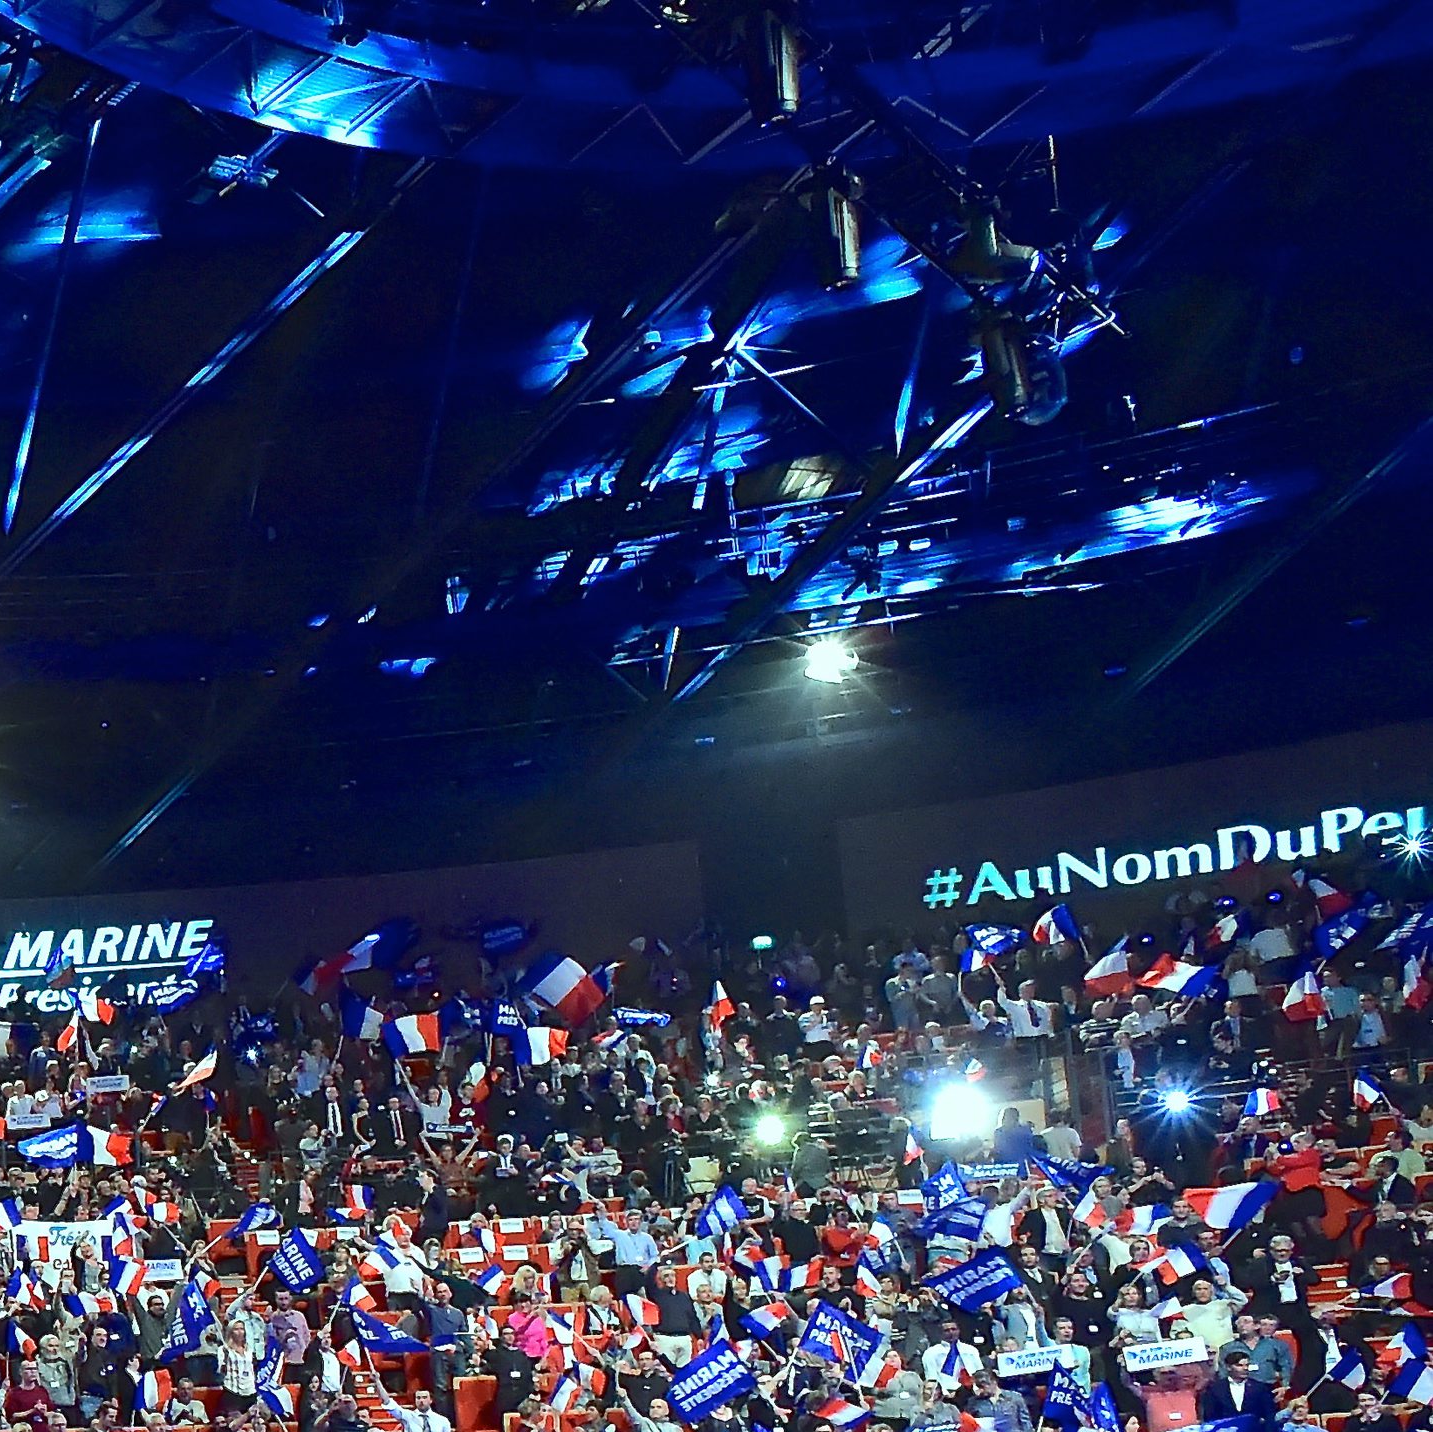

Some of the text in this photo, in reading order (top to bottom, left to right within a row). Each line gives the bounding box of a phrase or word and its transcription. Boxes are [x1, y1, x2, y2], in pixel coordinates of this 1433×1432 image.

[3, 920, 214, 970] MARINE
[1005, 1357, 1053, 1370] MARIN
[1138, 1349, 1193, 1364] MARINE
